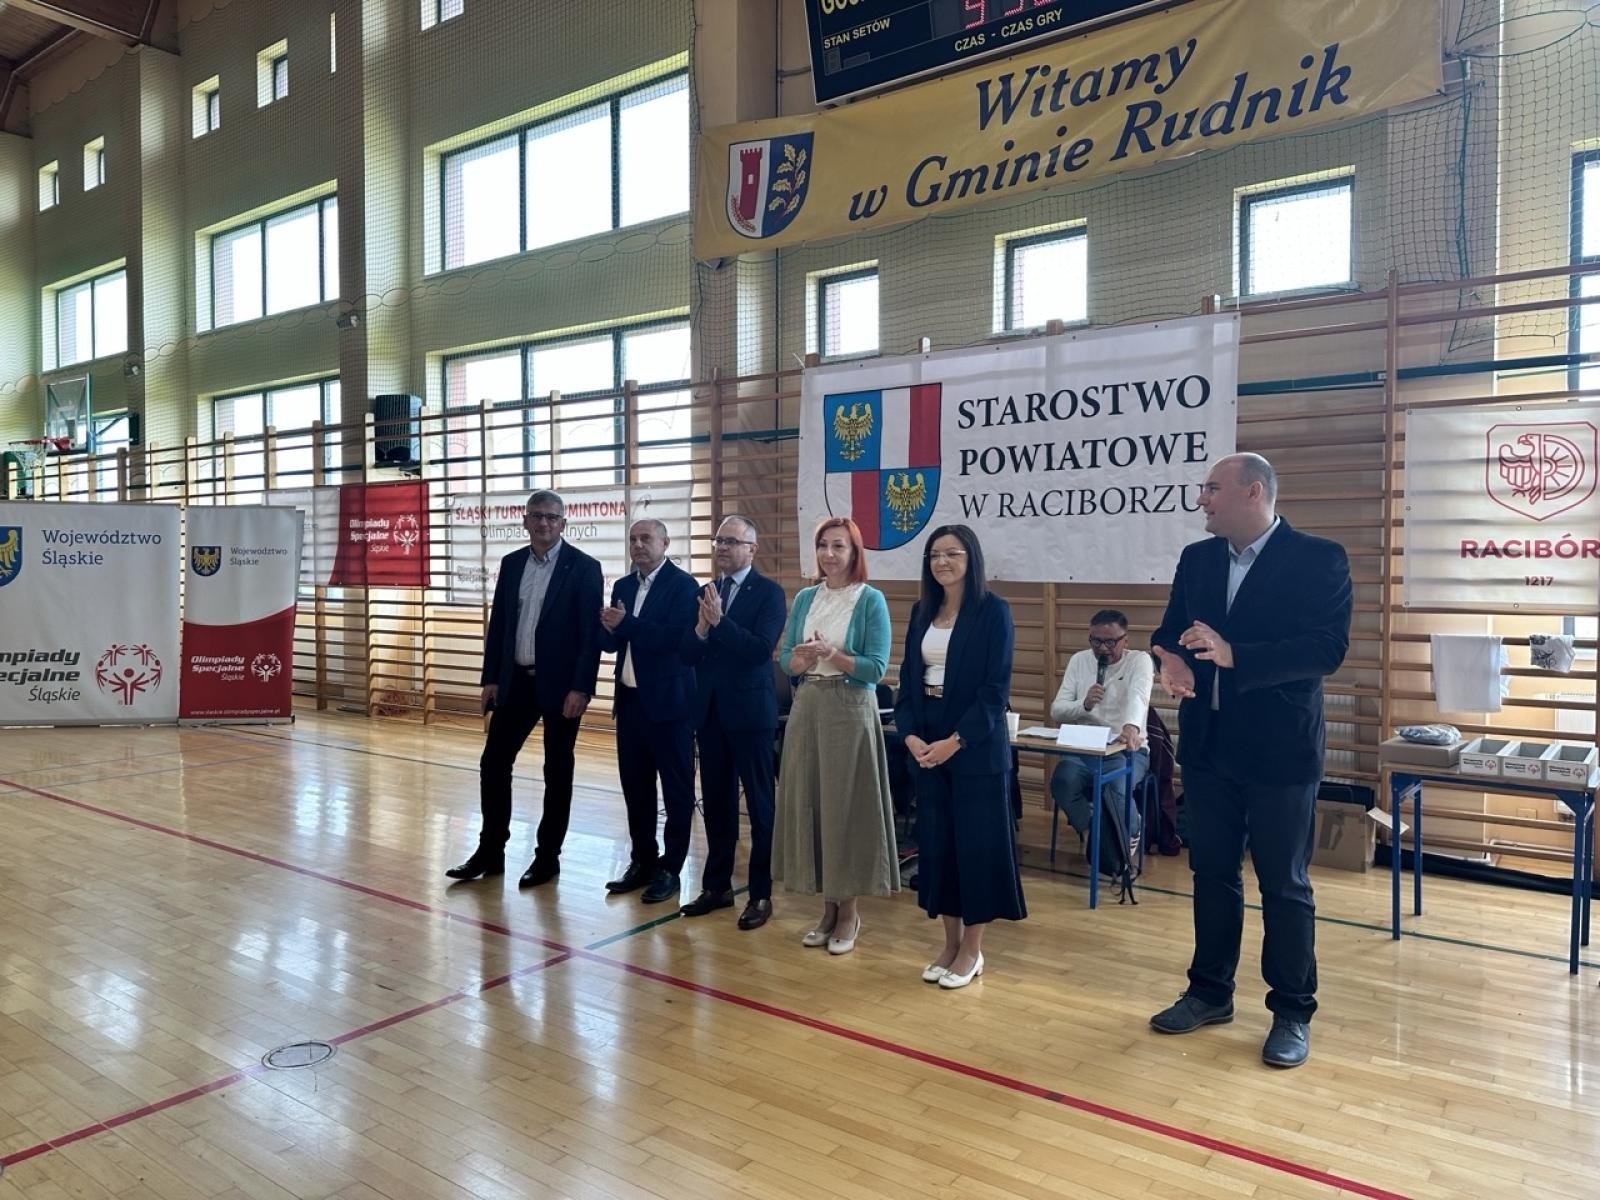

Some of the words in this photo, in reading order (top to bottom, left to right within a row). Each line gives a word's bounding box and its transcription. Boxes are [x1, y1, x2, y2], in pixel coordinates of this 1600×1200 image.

[824, 32, 850, 49] STAN
[852, 18, 890, 40] SETÓW
[954, 34, 986, 52] CZAS
[1001, 18, 1033, 38] CZAS
[1036, 8, 1063, 26] GRY
[977, 37, 1197, 132] Witamy
[848, 182, 889, 221] w
[906, 125, 1094, 209] Gminie
[1114, 43, 1352, 160] Rudnik
[958, 374, 1211, 430] STAROSTWO
[960, 431, 1209, 476] POWIATOWE
[455, 503, 491, 524] ŚLĄSKI
[959, 493, 989, 519] W
[998, 483, 1204, 518] RACIBORZU
[42, 529, 162, 547] Województwo
[41, 549, 104, 568] Śląskie
[1525, 576, 1554, 586] 1217
[190, 655, 245, 665] Olimpiady
[191, 664, 245, 674] Specjalne
[28, 685, 81, 704] Śląskie
